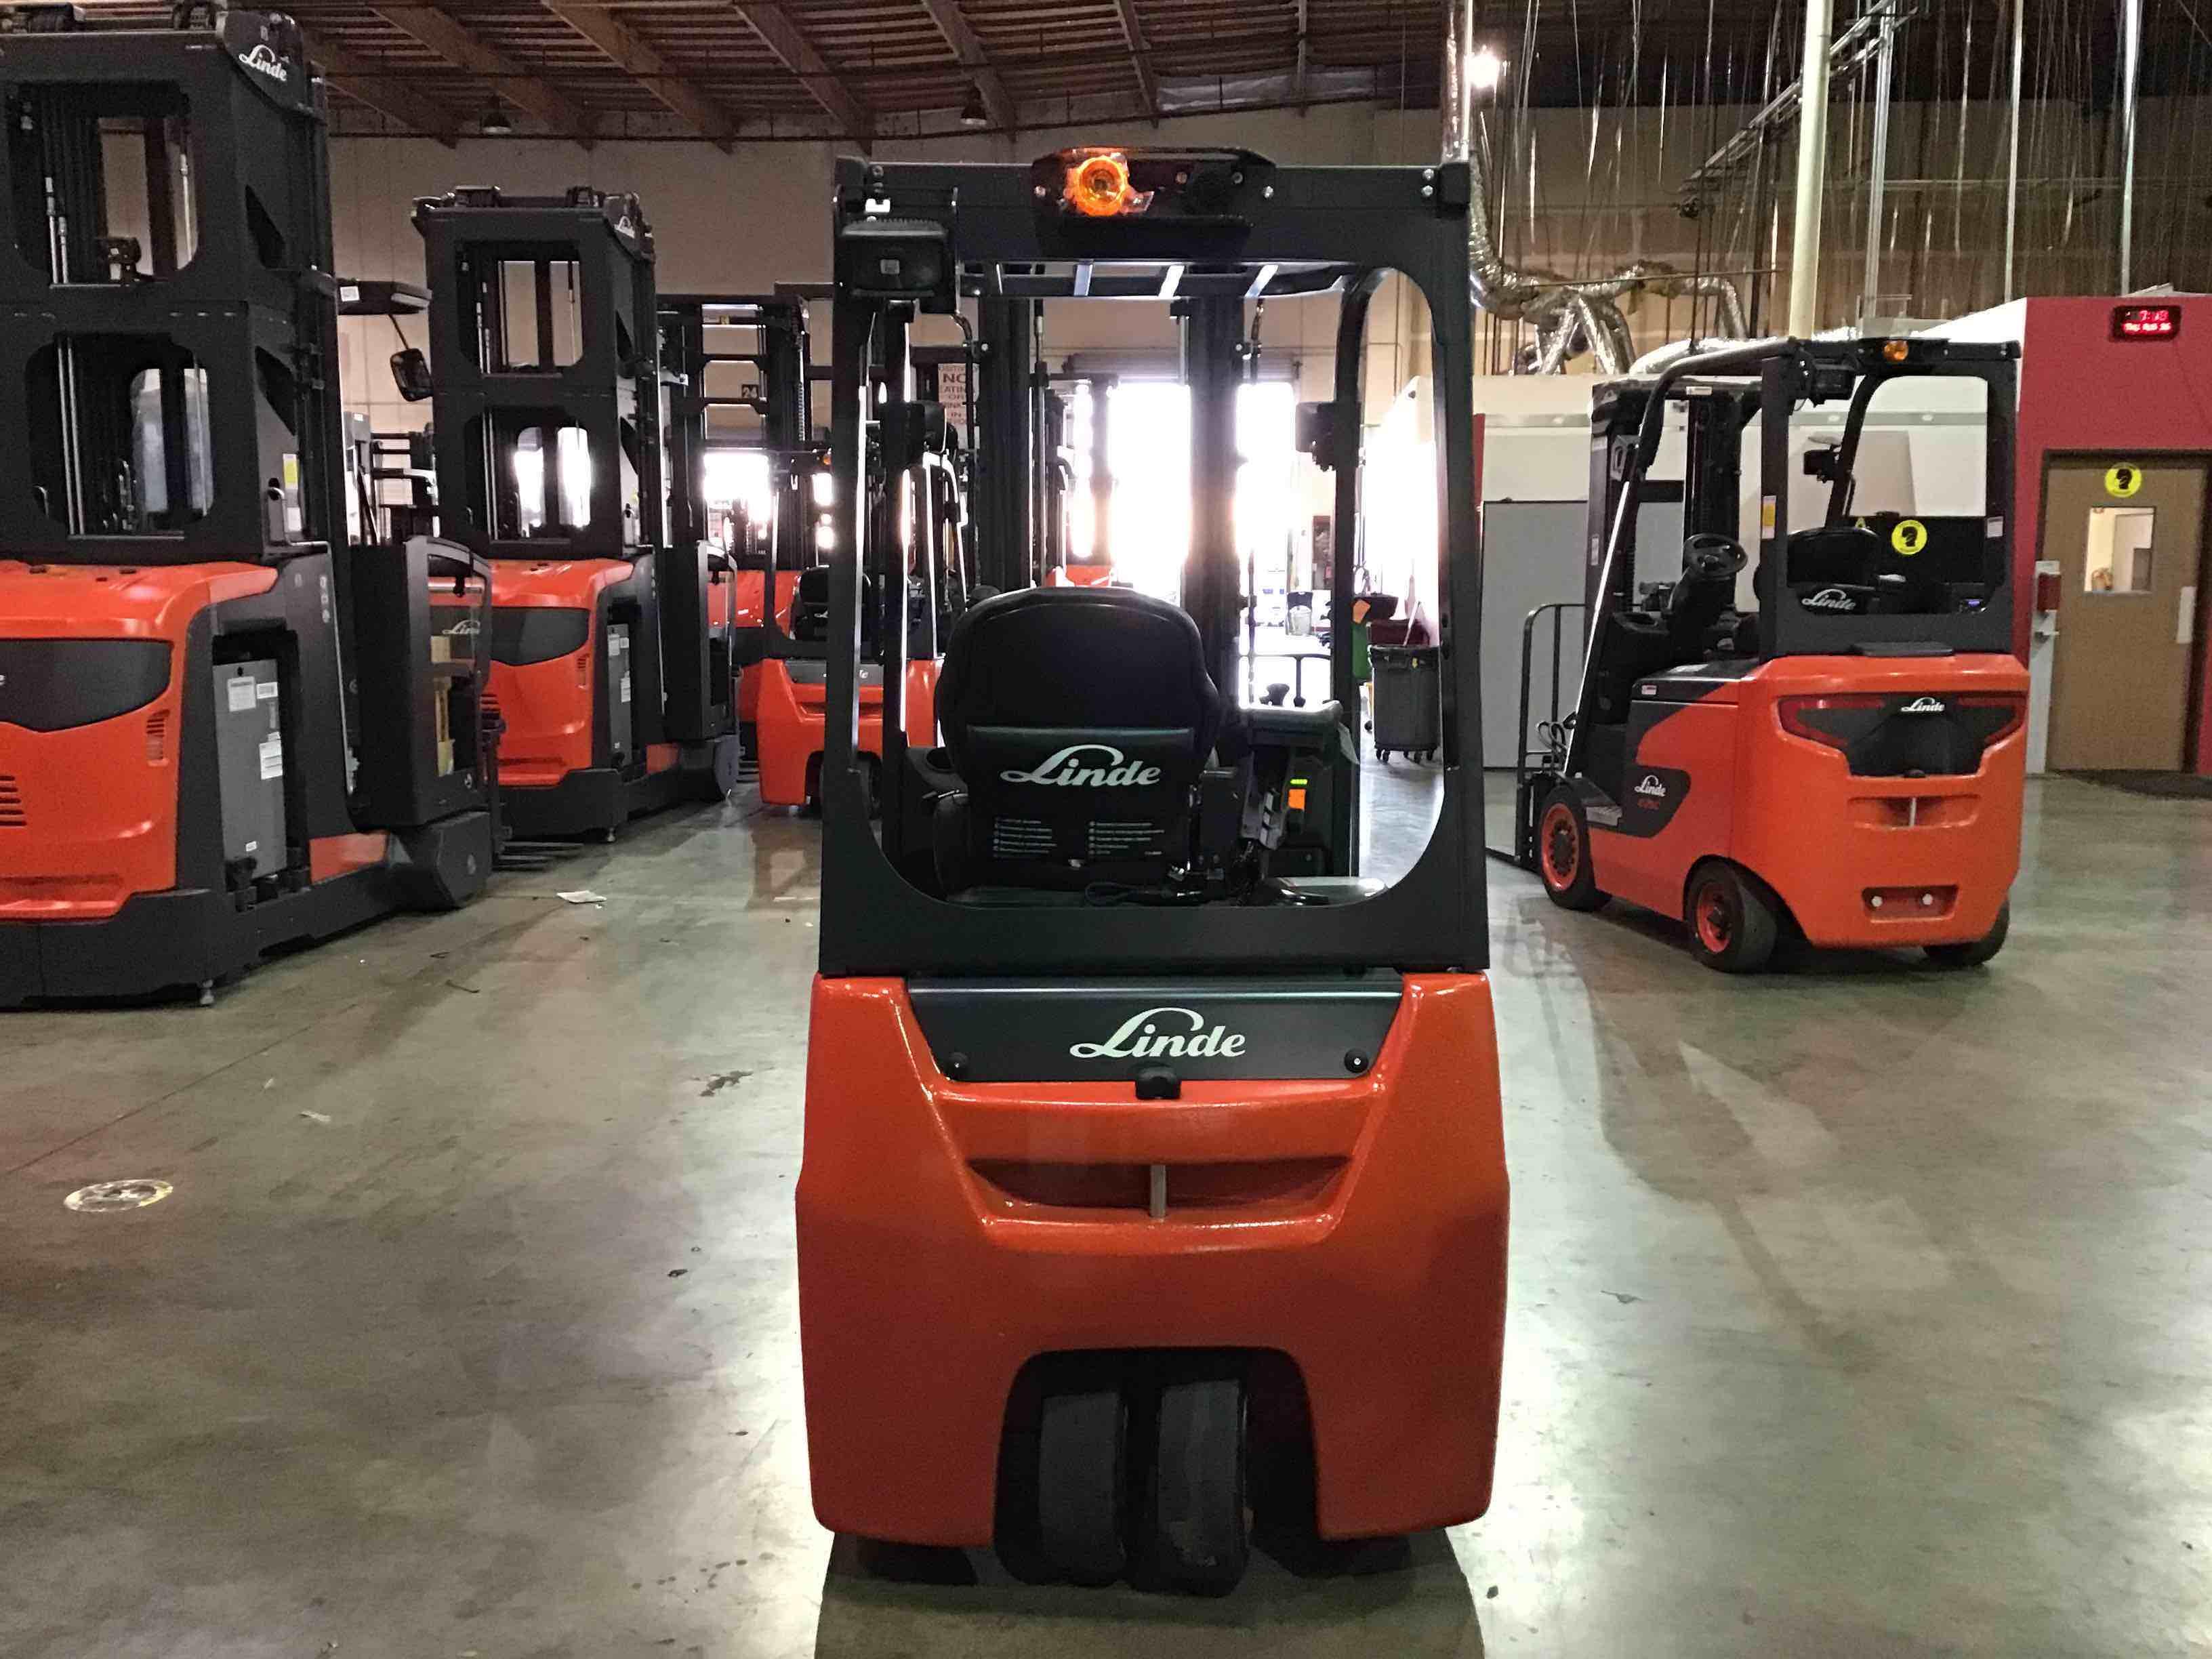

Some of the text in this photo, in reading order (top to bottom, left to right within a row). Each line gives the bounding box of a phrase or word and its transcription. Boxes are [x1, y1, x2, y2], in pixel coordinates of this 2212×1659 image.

[239, 45, 287, 81] Linde
[1801, 588, 1856, 610] Linde
[1901, 697, 1945, 712] Linde
[1000, 744, 1161, 787] Linde
[1634, 775, 1666, 797] Linde
[1069, 1007, 1246, 1058] Linde
